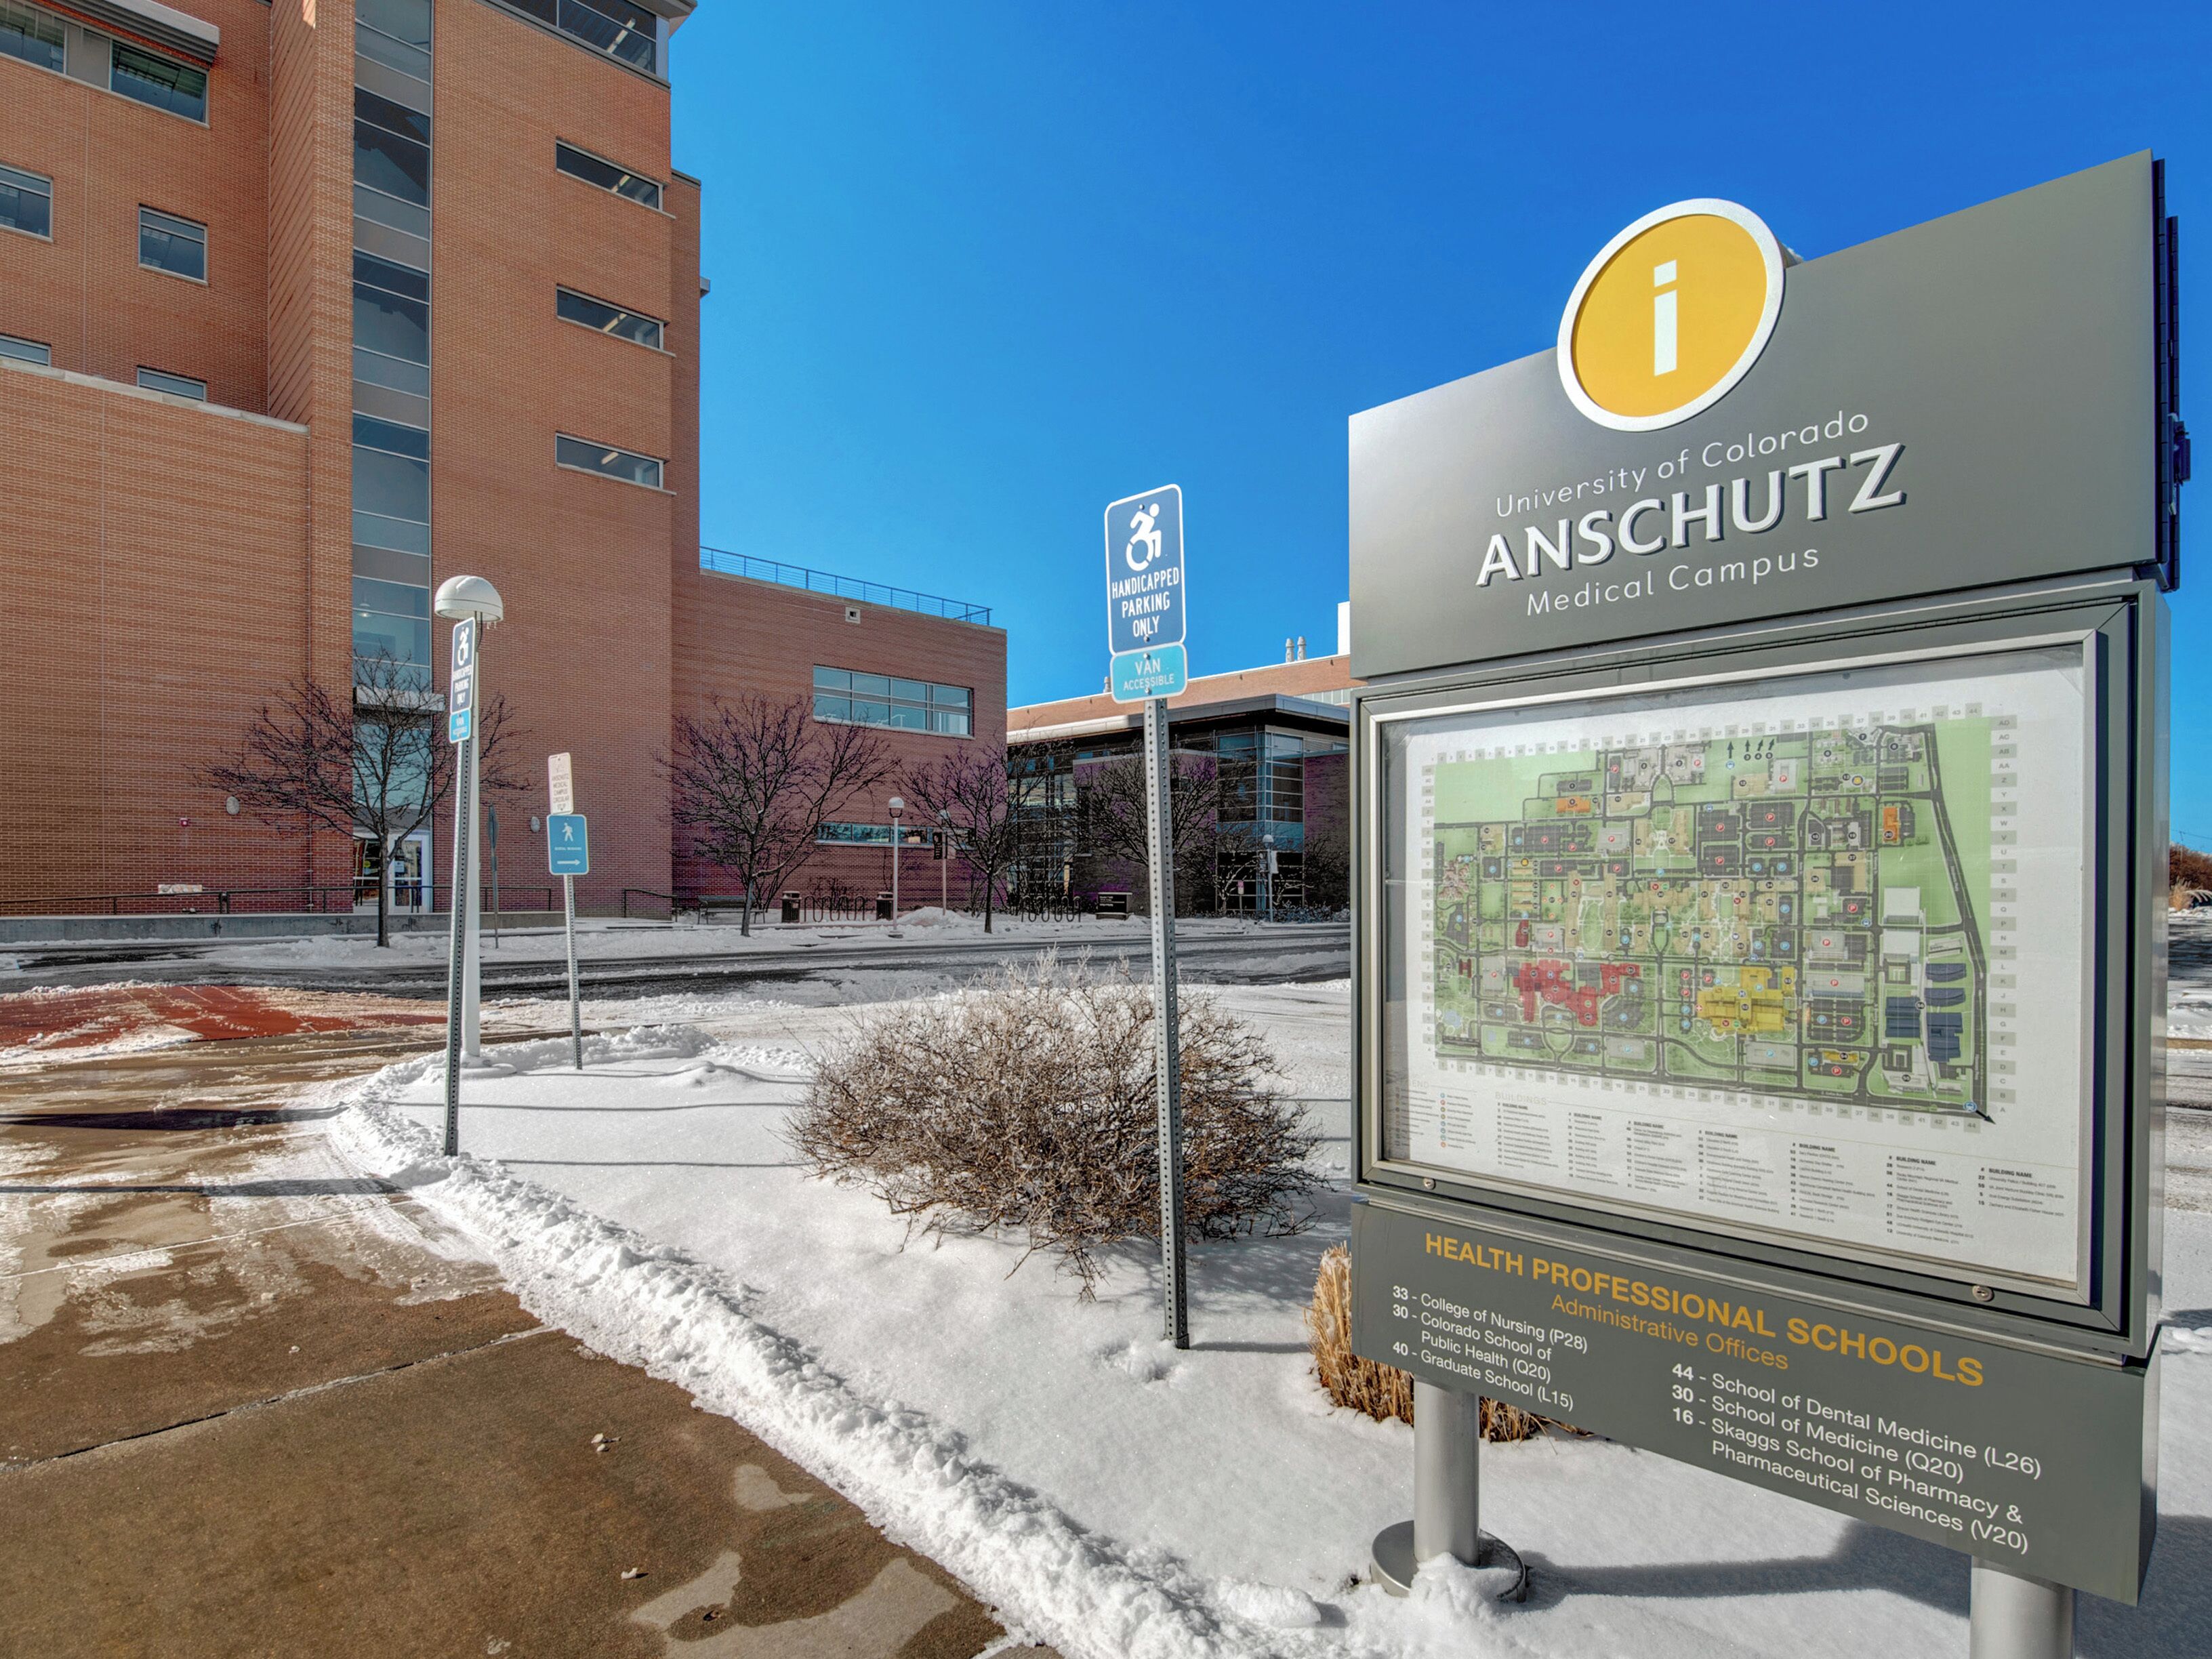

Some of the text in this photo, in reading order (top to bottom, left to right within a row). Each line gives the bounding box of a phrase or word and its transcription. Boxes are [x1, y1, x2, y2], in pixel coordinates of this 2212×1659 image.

[1496, 410, 1868, 517] University of Colorado
[1475, 443, 1904, 587] ANSCHUTZ
[1112, 567, 1179, 599] HANDICAPPED
[1122, 592, 1170, 618] PARKING
[1527, 549, 1819, 616] Medical Campus
[1132, 615, 1160, 637] ONLY
[1123, 673, 1174, 691] ACCESSIBLE
[1135, 659, 1161, 676] VAN
[1393, 1286, 1408, 1301] 33
[1421, 1293, 1469, 1319] College
[1473, 1308, 1487, 1323] of
[1491, 1313, 1544, 1343] Nursing
[1549, 1328, 1587, 1354] (P28)
[1393, 1304, 1408, 1319] 30
[1421, 1312, 1479, 1340] Colorado
[1484, 1330, 1533, 1357] School
[1537, 1346, 1552, 1361] of
[1425, 1233, 1984, 1387] HEALTH PROFESSIONAL SCHOOLS
[1551, 1294, 1788, 1370] Administrative Offices
[1393, 1341, 1408, 1357] 40
[1421, 1349, 1481, 1380] Graduate
[1485, 1369, 1533, 1397] School
[1538, 1385, 1574, 1412] (L15)
[1422, 1331, 1551, 1384] Public Health (Q20)
[1672, 1363, 1694, 1381] 44
[1712, 1373, 1775, 1404] School
[1781, 1392, 1800, 1410] of
[1807, 1398, 1870, 1430] Dental
[1878, 1417, 1976, 1460] Medicine
[1984, 1446, 2041, 1480] (L26)
[1672, 1385, 1694, 1403] 30
[1712, 1395, 1775, 1426] School
[1781, 1414, 1800, 1432] of
[1807, 1421, 1898, 1462] Medicine
[1906, 1449, 1964, 1483] (Q20)
[1673, 1407, 1694, 1425] 16
[1712, 1418, 1780, 1452] Skaggs
[1786, 1441, 1854, 1474] School
[1861, 1461, 1881, 1481] of
[1889, 1470, 1999, 1520] Pharmacy
[2007, 1504, 2022, 1524] &
[1713, 1441, 2028, 1555] Pharmaceutical Sciences (V20)
